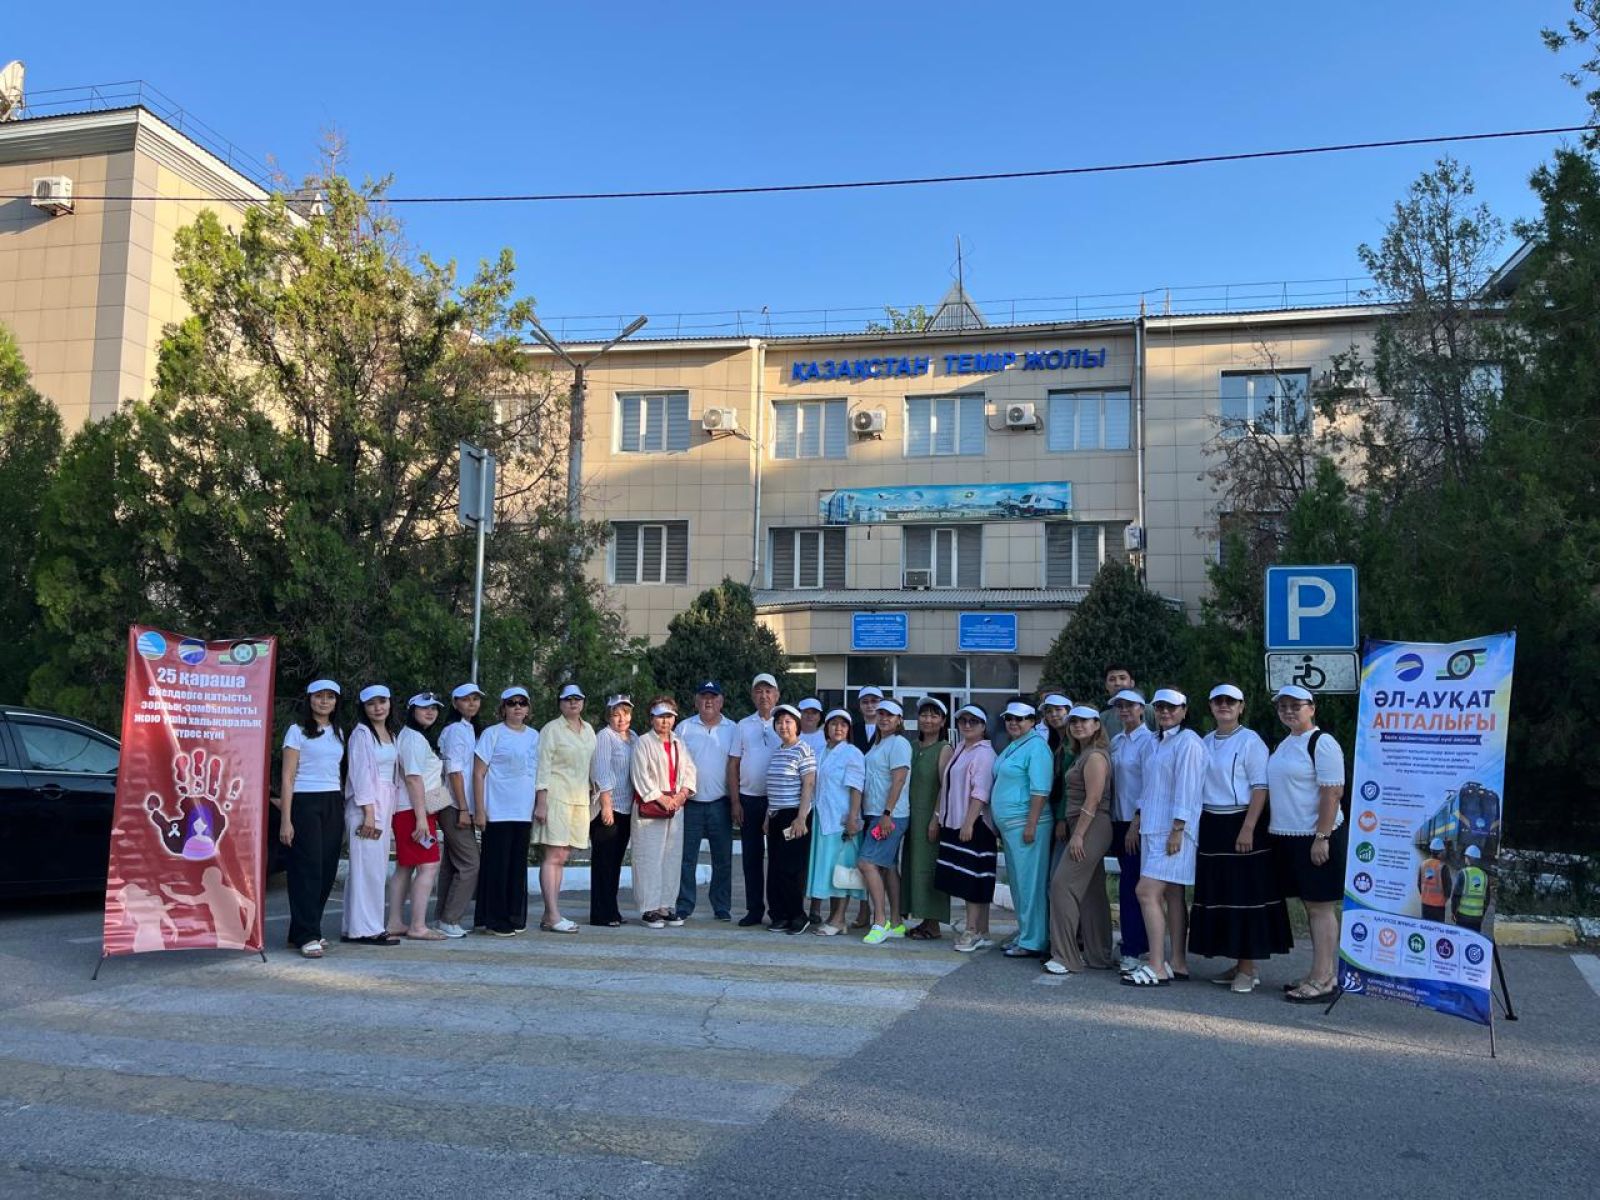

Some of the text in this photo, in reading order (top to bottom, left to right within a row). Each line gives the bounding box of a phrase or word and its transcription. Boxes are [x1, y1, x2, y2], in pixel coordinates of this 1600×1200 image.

[792, 347, 1106, 383] ҚАЗАҚСТАН ТЕМІР ЖОЛЫ
[1287, 575, 1336, 640] P
[156, 667, 177, 684] 25
[1374, 689, 1496, 711] ӘЛ-АУҚАТ
[1372, 711, 1496, 732] АПТАЛЫҒЫ
